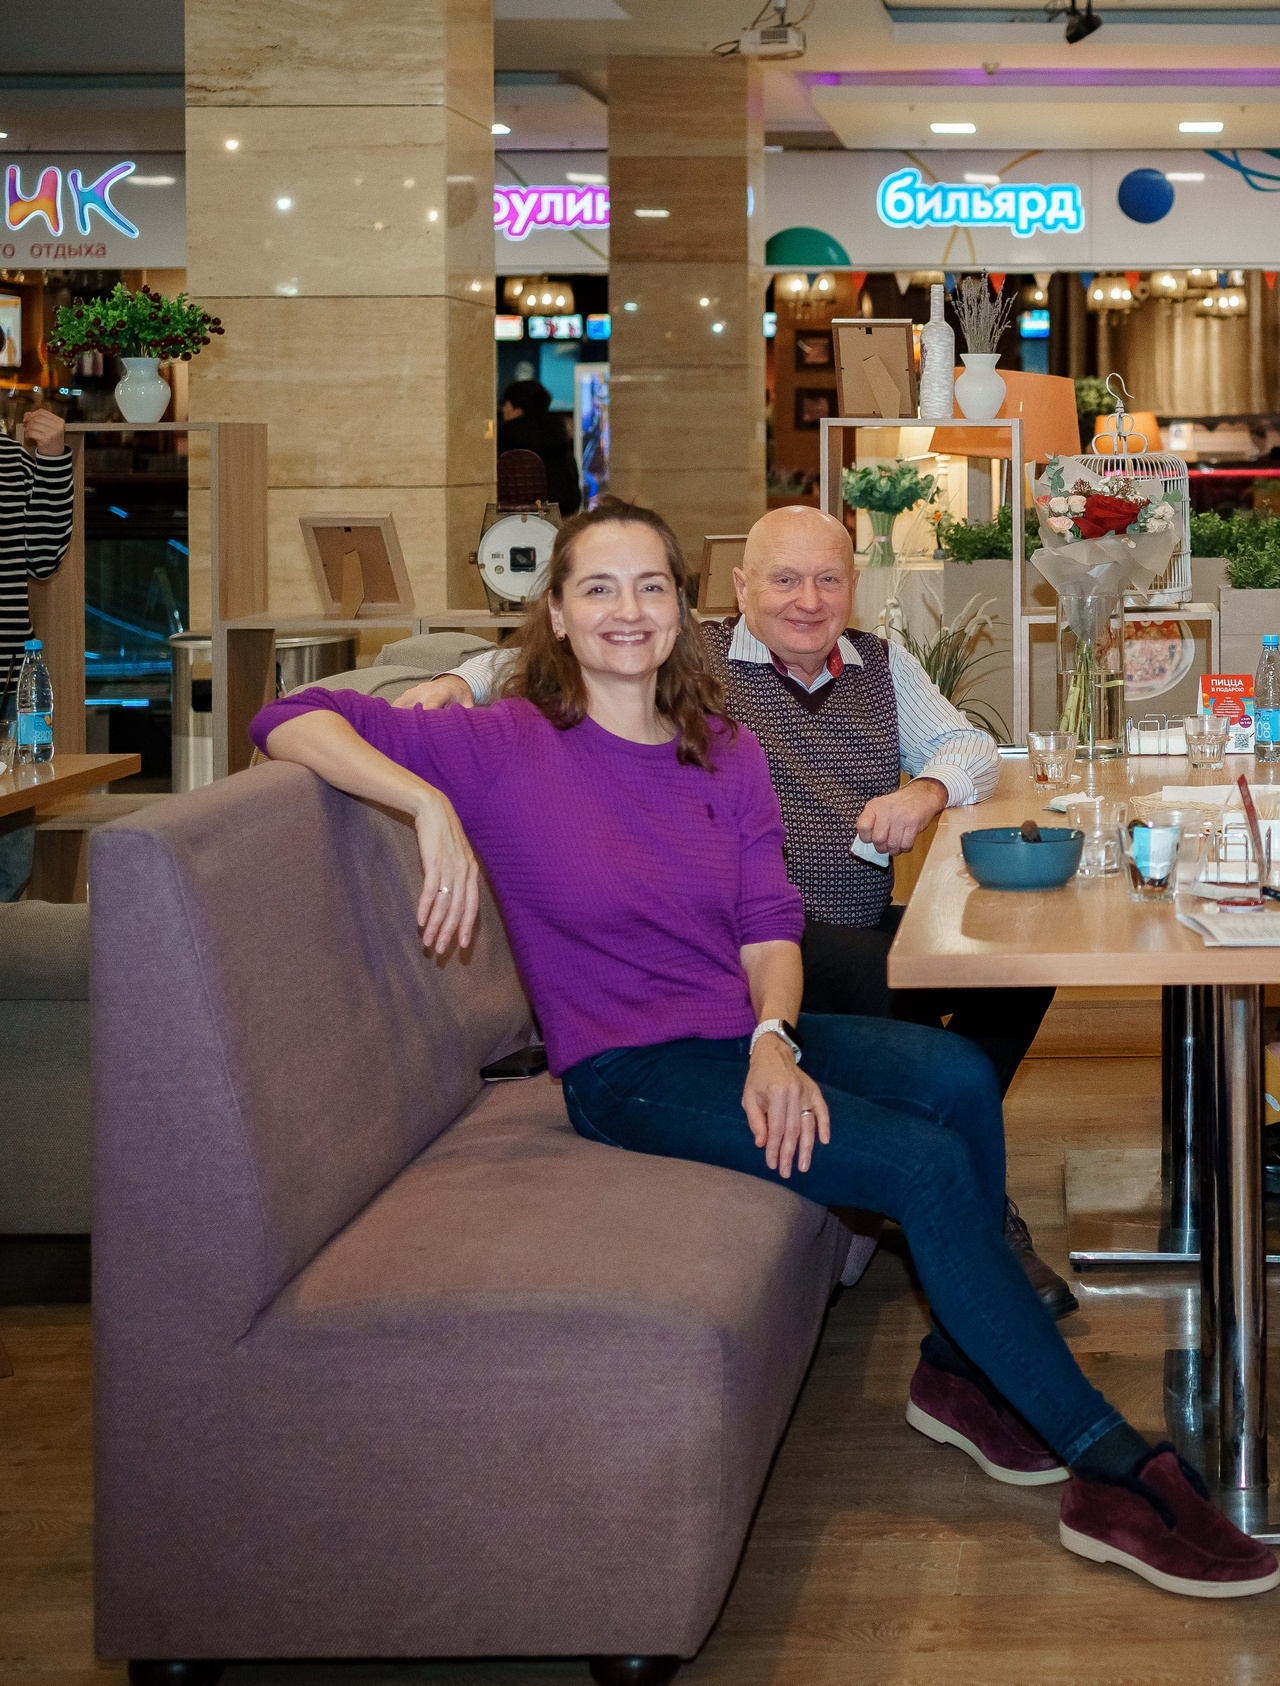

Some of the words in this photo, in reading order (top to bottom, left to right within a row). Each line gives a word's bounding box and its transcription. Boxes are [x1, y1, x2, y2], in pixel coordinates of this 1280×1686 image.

[881, 172, 1080, 233] бильярд
[29, 241, 108, 260] отдыха
[1211, 678, 1244, 687] ПИЦЦА
